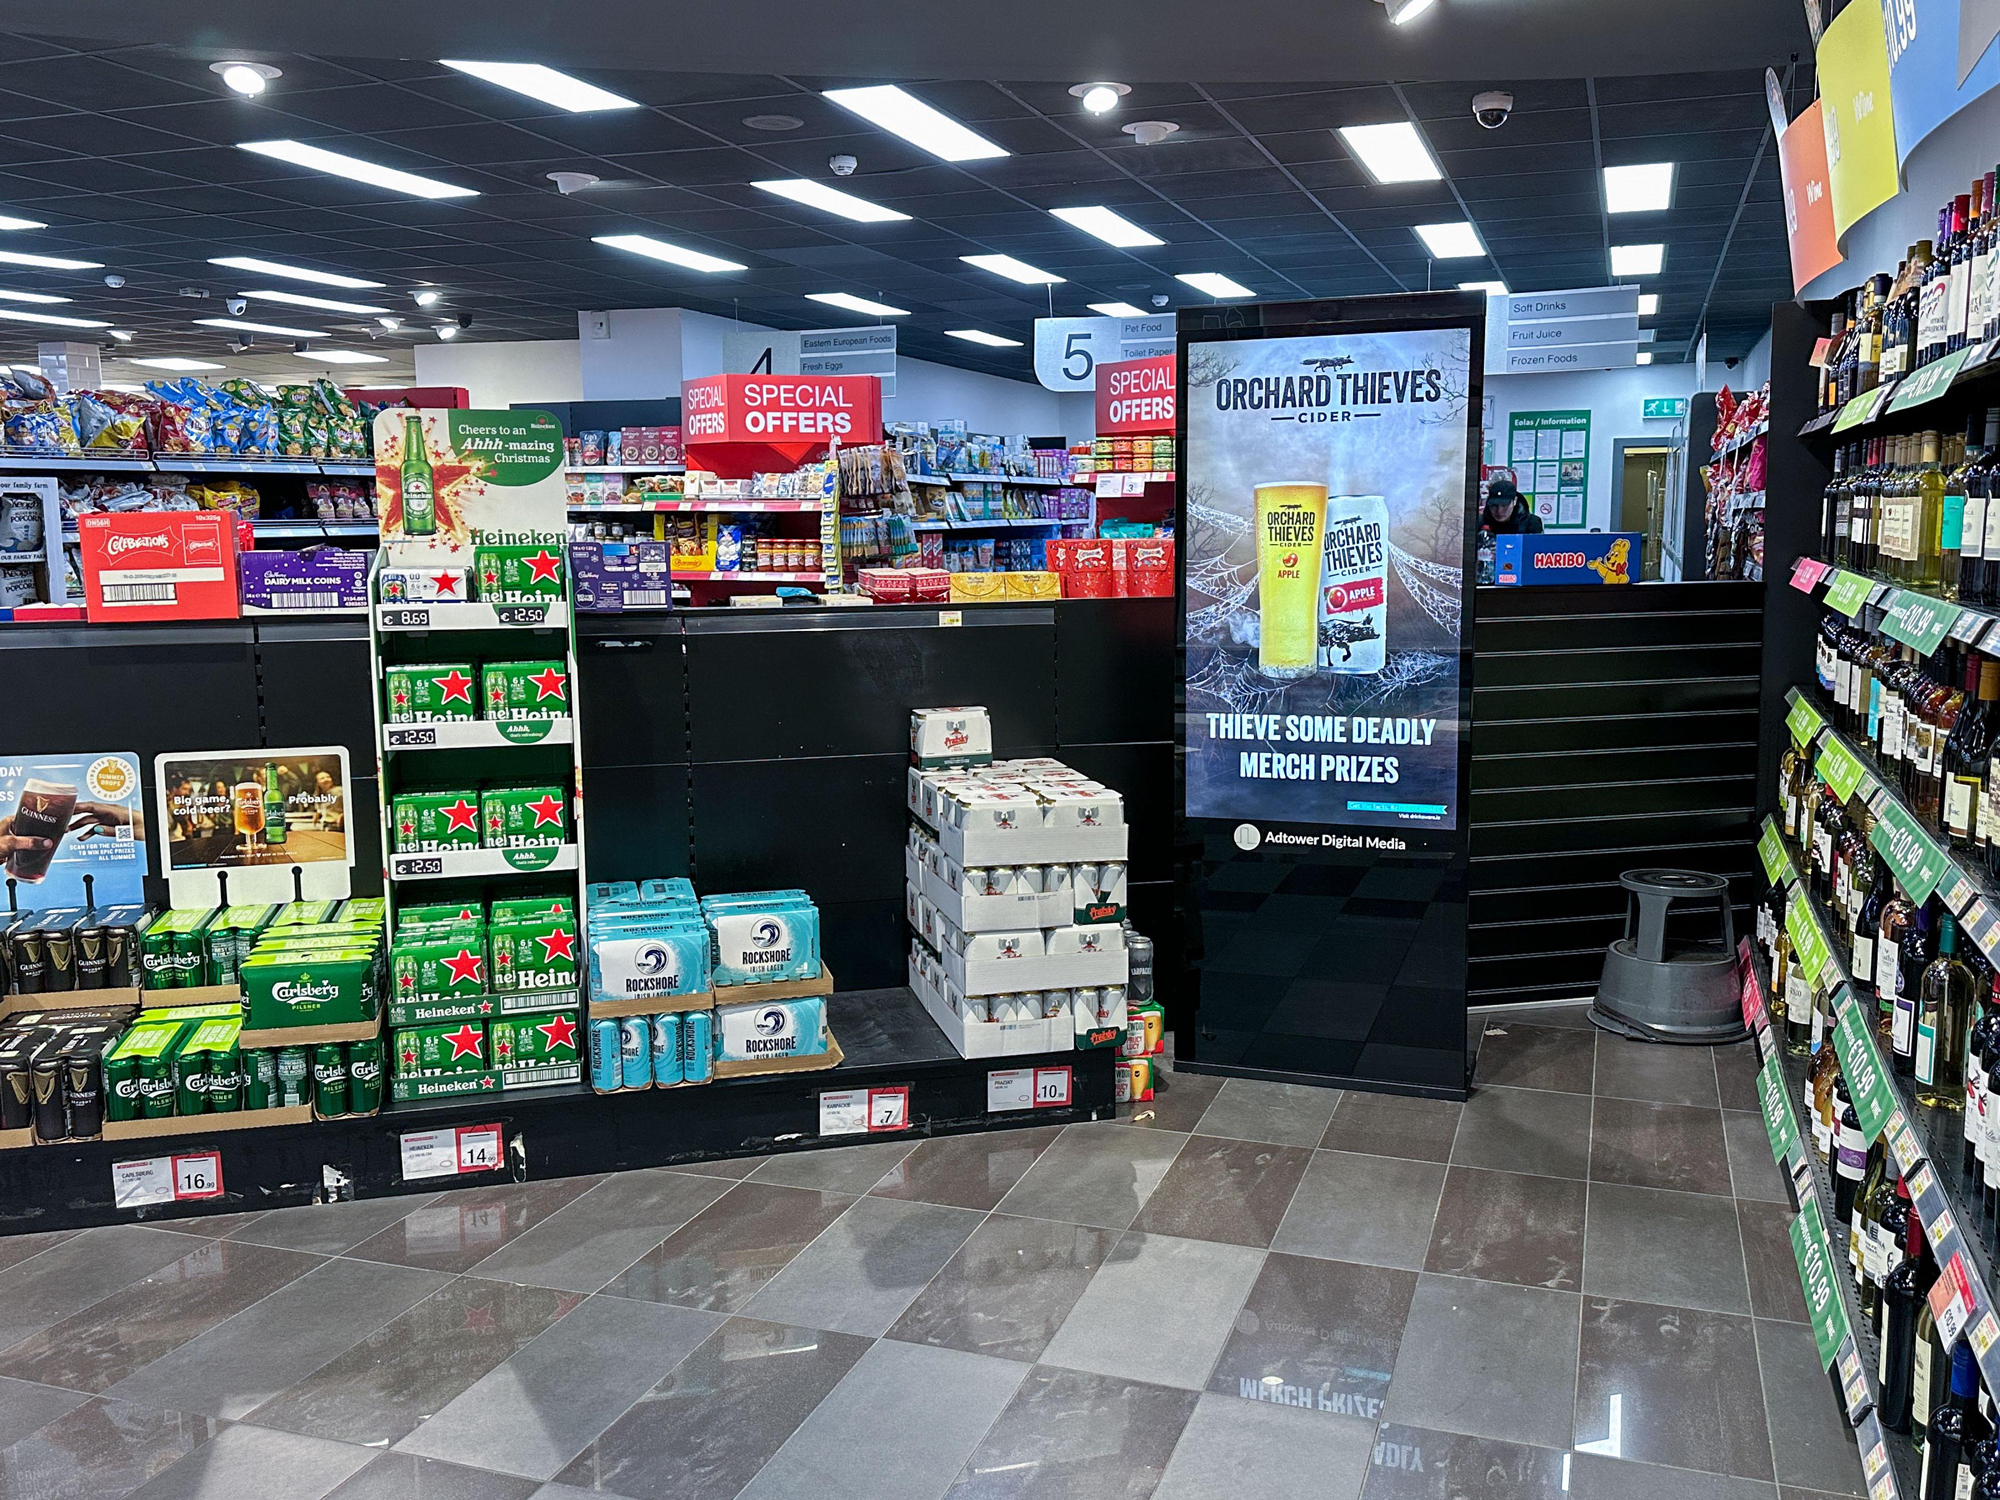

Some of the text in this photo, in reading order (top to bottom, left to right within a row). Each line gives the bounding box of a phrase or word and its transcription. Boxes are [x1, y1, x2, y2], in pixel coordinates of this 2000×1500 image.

[1853, 91, 1873, 124] Wine
[1806, 180, 1823, 206] Wine
[1513, 301, 1566, 313] Soft Drinks
[1125, 323, 1162, 333] Pet Food
[1512, 329, 1562, 340] Fruit Juice
[803, 334, 892, 349] Eastern European Foods
[1063, 333, 1093, 381] 5
[1124, 347, 1173, 358] Toilet Paper
[1511, 353, 1577, 366] Frozen Foods
[802, 360, 843, 372] Fresh Eggs
[1110, 366, 1175, 396] SPECIAL
[688, 383, 725, 410] SPECIAL
[744, 383, 853, 408] SPECIAL
[1216, 369, 1441, 410] ORCHARD THIEVES
[1110, 395, 1174, 423] OFFERS
[688, 412, 725, 436] OFFERS
[745, 411, 852, 434] OFFERS
[1298, 411, 1351, 424] CIDER
[1514, 418, 1534, 427] Eolas
[1541, 415, 1587, 427] Information
[458, 424, 527, 436] Cheers to an
[530, 422, 556, 430] Heineken
[494, 452, 551, 464] Christmas
[13, 481, 32, 490] family
[34, 481, 48, 489] farm
[1267, 511, 1316, 526] ORCHARD
[469, 528, 568, 546] Heineken
[1267, 526, 1314, 542] THIEVES
[1324, 522, 1381, 551] ORCHARD
[1325, 541, 1383, 572] THIEVES
[1534, 551, 1585, 569] HARIBO
[264, 570, 287, 579] Cadbury
[578, 570, 600, 580] Cadbury
[1277, 570, 1300, 579] APPLE
[1341, 565, 1371, 577] CIDER
[264, 578, 290, 586] DAIRY
[314, 577, 341, 585] COINS
[1349, 586, 1376, 600] APPLE
[401, 611, 428, 624] 8.69
[514, 608, 543, 621] 12.50
[1900, 603, 1935, 638] €10.99
[404, 730, 434, 743] 12.50
[506, 725, 531, 733] Ahhh,
[1205, 712, 1436, 746] THIEVE SOME DEADLY
[0, 766, 23, 778] DAY
[1239, 751, 1400, 784] MERCH PRIZES
[173, 795, 230, 806] Big game,
[288, 793, 338, 806] Probably
[21, 806, 58, 823] GUINNESS
[173, 804, 231, 816] cold beer?
[1265, 831, 1406, 851] Adtower Digital Media
[512, 852, 536, 860] Ahhh,
[1889, 826, 1934, 883] €10.99 WINE
[411, 859, 441, 873] 12.50
[78, 958, 106, 967] GUINNESS
[742, 948, 791, 965] ROCKSHORE
[749, 963, 784, 973] IRISH LAGER
[626, 974, 679, 993] ROCKSHORE
[271, 980, 339, 1003] Carlsberg
[292, 1003, 321, 1011] PILSNER
[415, 1003, 475, 1019] Heineken
[685, 1020, 696, 1061] ROCKSHORE
[745, 1036, 797, 1054] ROCKSHORE
[593, 1029, 602, 1070] ROCKSHORE
[1847, 1039, 1877, 1099] €10.99
[418, 1078, 478, 1095] Heineken
[1764, 1082, 1785, 1128] €10.99
[409, 1143, 434, 1152] HEINEKEN
[121, 1170, 154, 1180] CARLSBERG
[1802, 1242, 1831, 1313] €10.99
[1825, 1314, 1836, 1341] WINE
